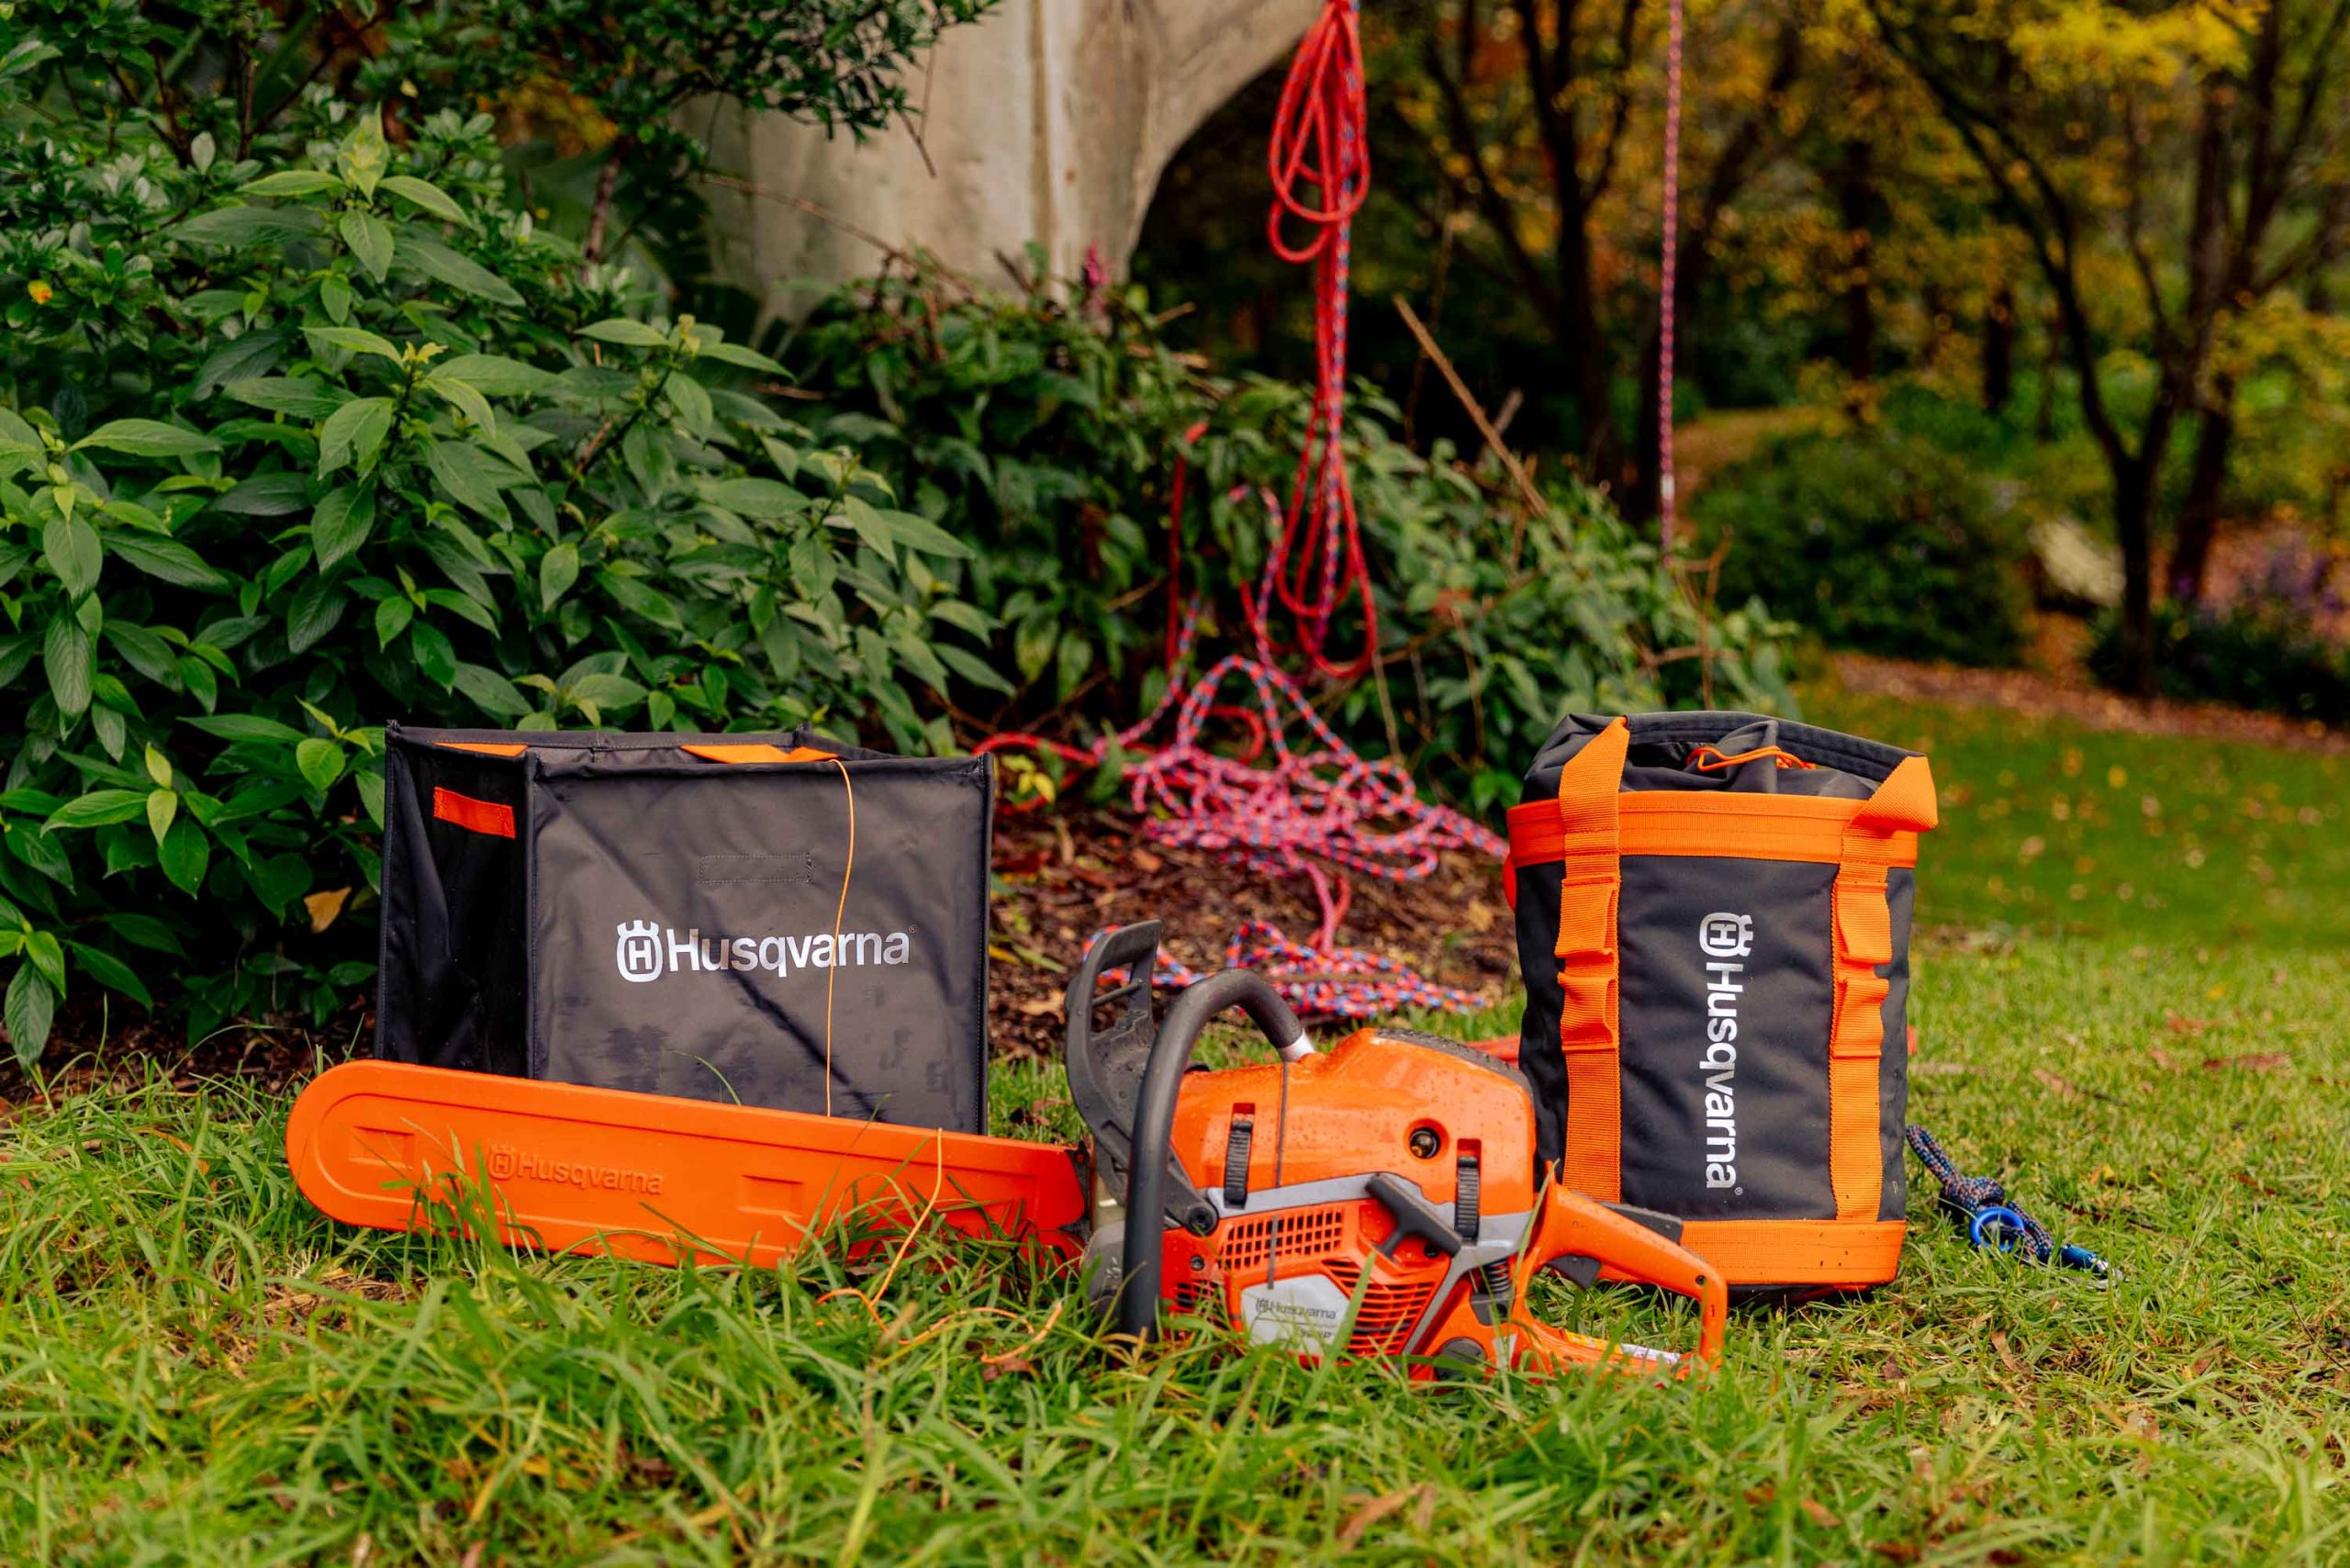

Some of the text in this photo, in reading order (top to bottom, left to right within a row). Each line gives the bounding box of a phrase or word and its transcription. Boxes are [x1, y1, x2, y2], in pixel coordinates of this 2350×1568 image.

[666, 928, 910, 977] Husqvarna
[1699, 962, 1743, 1189] Husqvarna
[517, 1152, 665, 1195] Husqvarna
